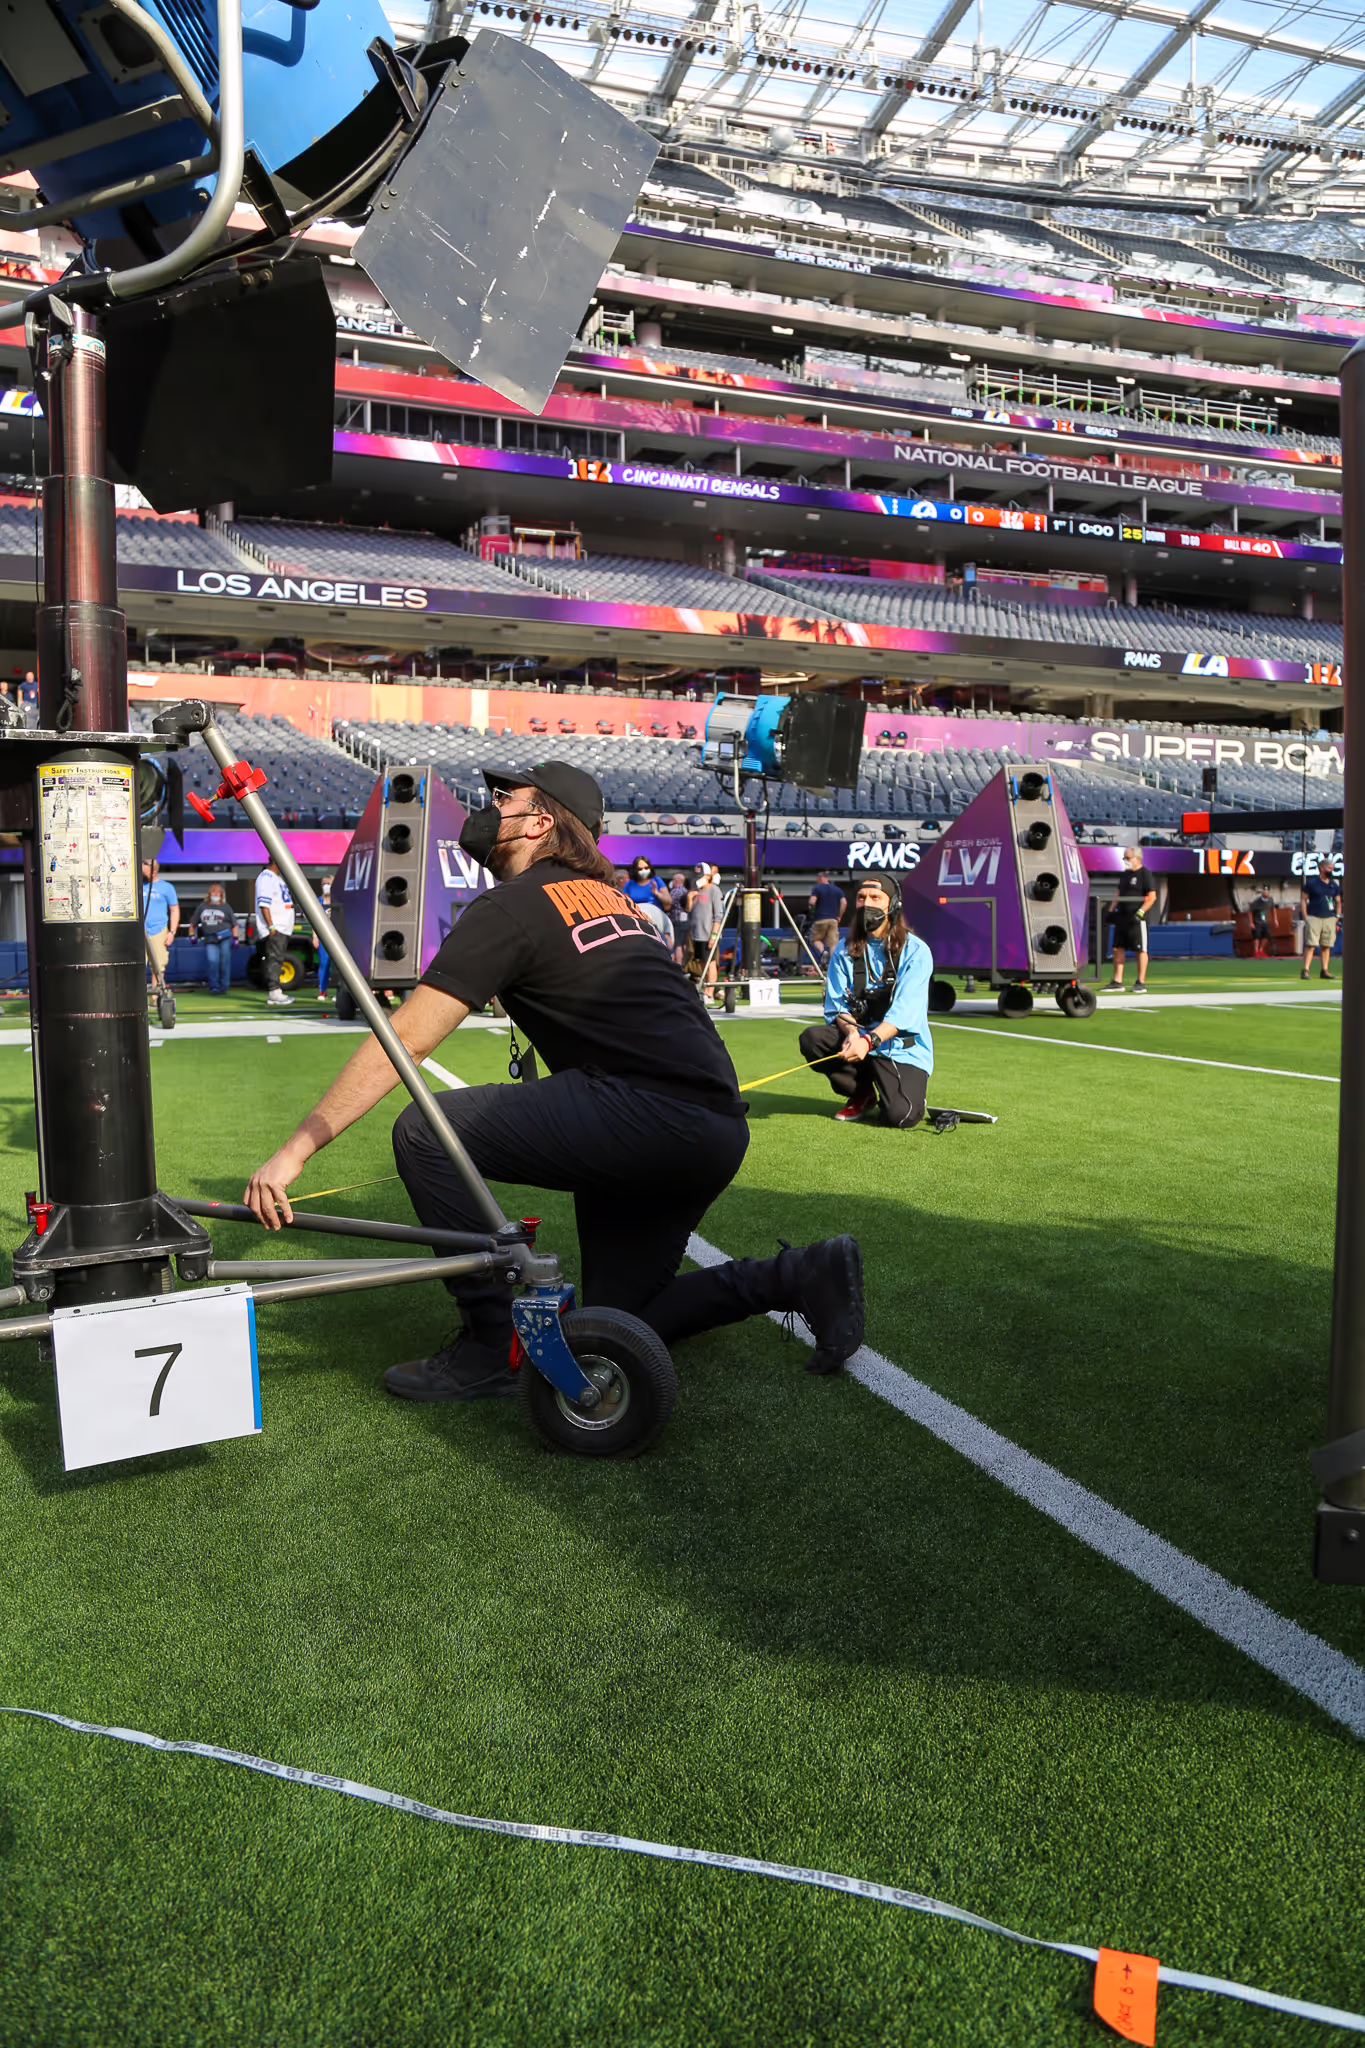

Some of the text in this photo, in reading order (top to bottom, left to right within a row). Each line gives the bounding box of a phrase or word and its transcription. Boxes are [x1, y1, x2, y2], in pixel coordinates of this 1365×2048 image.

[774, 248, 816, 264] SUPER
[817, 256, 855, 271] BOWL
[337, 315, 418, 337] ANGELE
[894, 444, 1204, 497] NATIONAL FOOTBALL LEAGUE
[622, 468, 780, 500] CINCINNATI BENGALS
[1078, 522, 1114, 537] 0:00
[1122, 527, 1143, 540] 25
[1252, 542, 1272, 553] 40
[177, 569, 428, 609] LOS ANGELES
[1124, 651, 1162, 669] RAMS
[1091, 731, 1345, 779] SUPER BOW
[847, 841, 921, 870] RAMS
[344, 849, 374, 891] LVI
[938, 846, 1002, 886] LVI
[757, 987, 773, 1001] 17
[134, 1342, 183, 1418] 7
[285, 1768, 304, 1779] LB
[311, 1773, 346, 1788] 1250
[385, 1794, 406, 1807] FT
[580, 1831, 621, 1845] 1250
[673, 1846, 698, 1859] FT
[858, 1882, 883, 1897] LB
[892, 1889, 937, 1909] 1250
